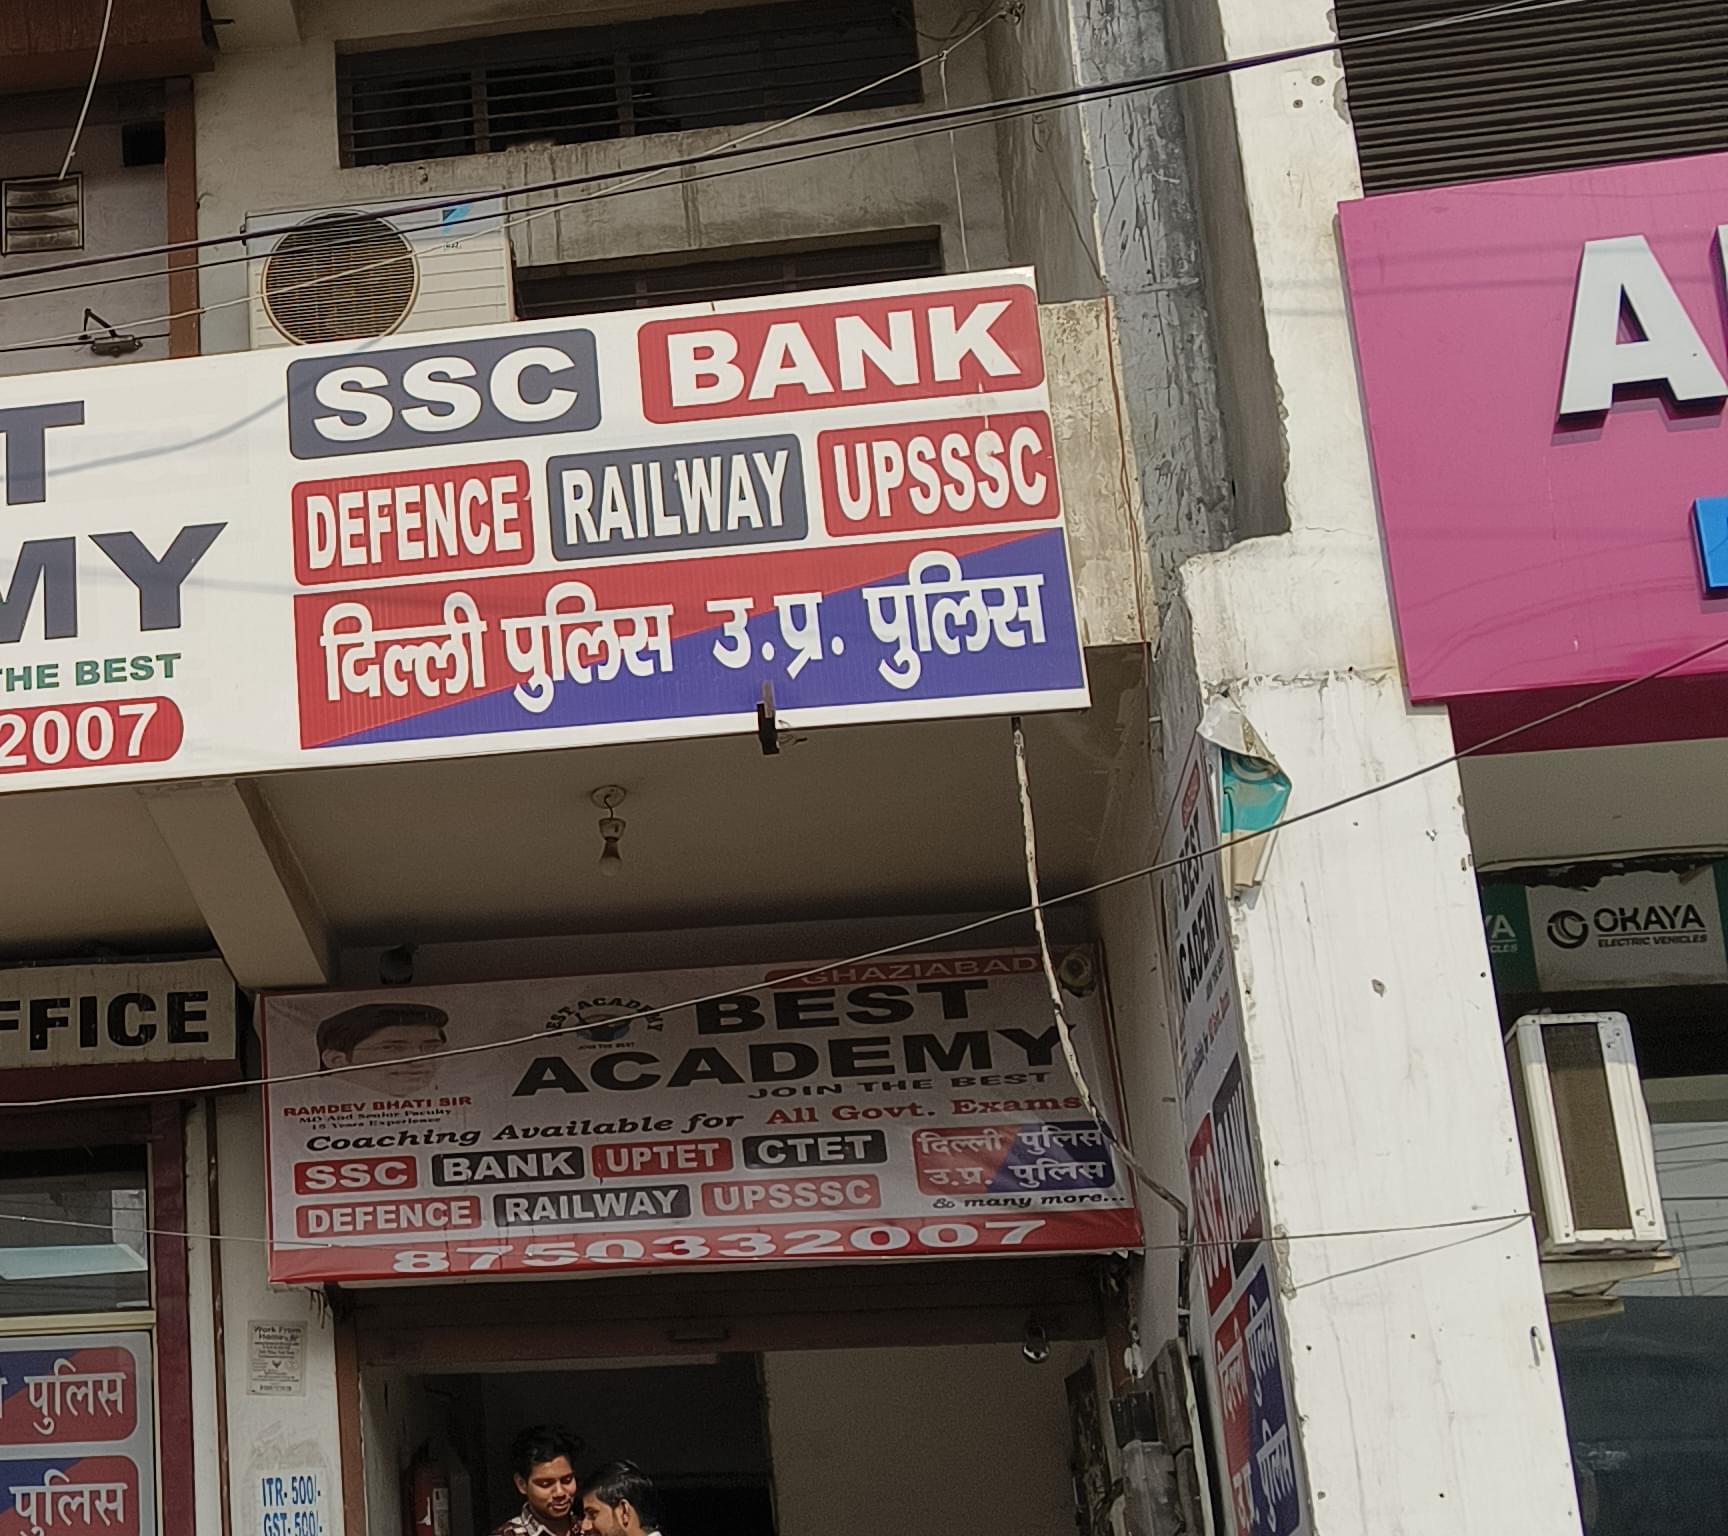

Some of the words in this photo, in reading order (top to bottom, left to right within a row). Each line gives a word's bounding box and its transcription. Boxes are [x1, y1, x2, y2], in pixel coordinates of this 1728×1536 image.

[312, 345, 579, 443] SSC
[669, 298, 1023, 409] BANK
[305, 476, 524, 571] DEFENCE
[561, 448, 789, 547] RAILWAY
[831, 424, 1048, 523] UPSSSC
[319, 591, 488, 702] दिल्ली
[500, 580, 674, 713] पुलिस
[862, 549, 1047, 690] पुलिस
[73, 652, 183, 688] BEST
[1593, 904, 1706, 933] OKAYA
[1598, 936, 1650, 948] ELECTRIC
[1653, 934, 1707, 946] VEHICLES
[799, 955, 1042, 986] GHAZIABAD
[696, 979, 989, 1036] BEST
[511, 1023, 1076, 1098] ACADEMY
[747, 1082, 843, 1100] JOIN
[857, 1077, 934, 1093] THE
[951, 1070, 1052, 1089] BEST
[283, 1102, 366, 1117] RAMDEV
[372, 1098, 432, 1111] BHATI
[439, 1096, 473, 1107] SIR
[306, 1129, 481, 1152] Coaching
[492, 1117, 675, 1142] Available
[680, 1113, 744, 1135] for
[766, 1107, 819, 1126] All
[832, 1100, 936, 1124] Govt.
[951, 1095, 1083, 1116] Exams
[303, 1161, 409, 1191] SSC
[441, 1150, 576, 1184] BANK
[605, 1142, 720, 1174] UPTET
[756, 1135, 873, 1164] CTET
[918, 1128, 1005, 1156] दिल्ली
[1018, 1126, 1103, 1156] पुलिस
[964, 1194, 1032, 1209] many
[1008, 1159, 1106, 1190] पुलिस
[1194, 1142, 1233, 1288] SSC
[1217, 1079, 1259, 1245] BANK
[308, 1200, 473, 1234] DEFENCE
[504, 1189, 680, 1224] RAILWAY
[714, 1178, 873, 1212] UPSSSC
[392, 1219, 1047, 1275] 8750332007
[24, 1358, 126, 1435] पुलिस
